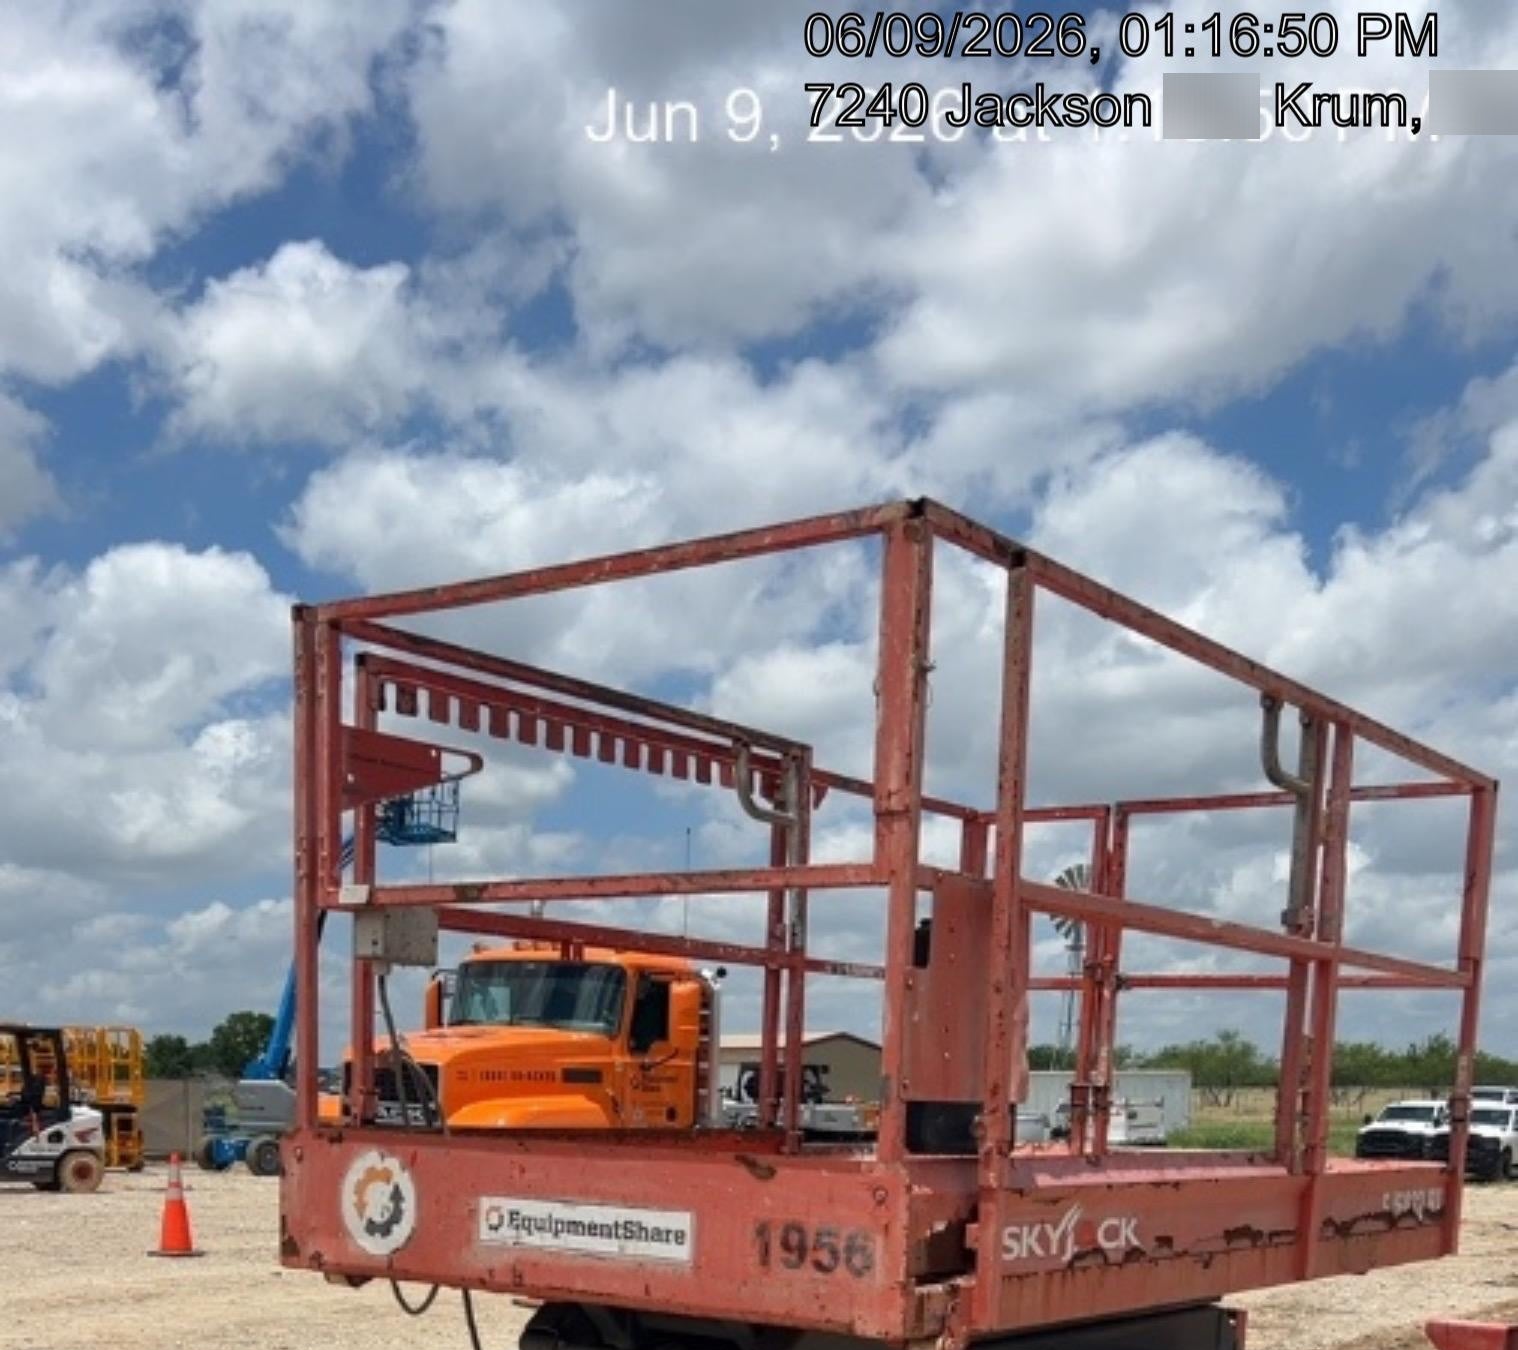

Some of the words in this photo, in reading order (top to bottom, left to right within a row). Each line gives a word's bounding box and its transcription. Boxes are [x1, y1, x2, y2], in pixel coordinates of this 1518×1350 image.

[506, 1210, 686, 1246] EquipmentShare
[752, 1221, 875, 1278] 1956
[1002, 1201, 1141, 1262] SKYJCK
